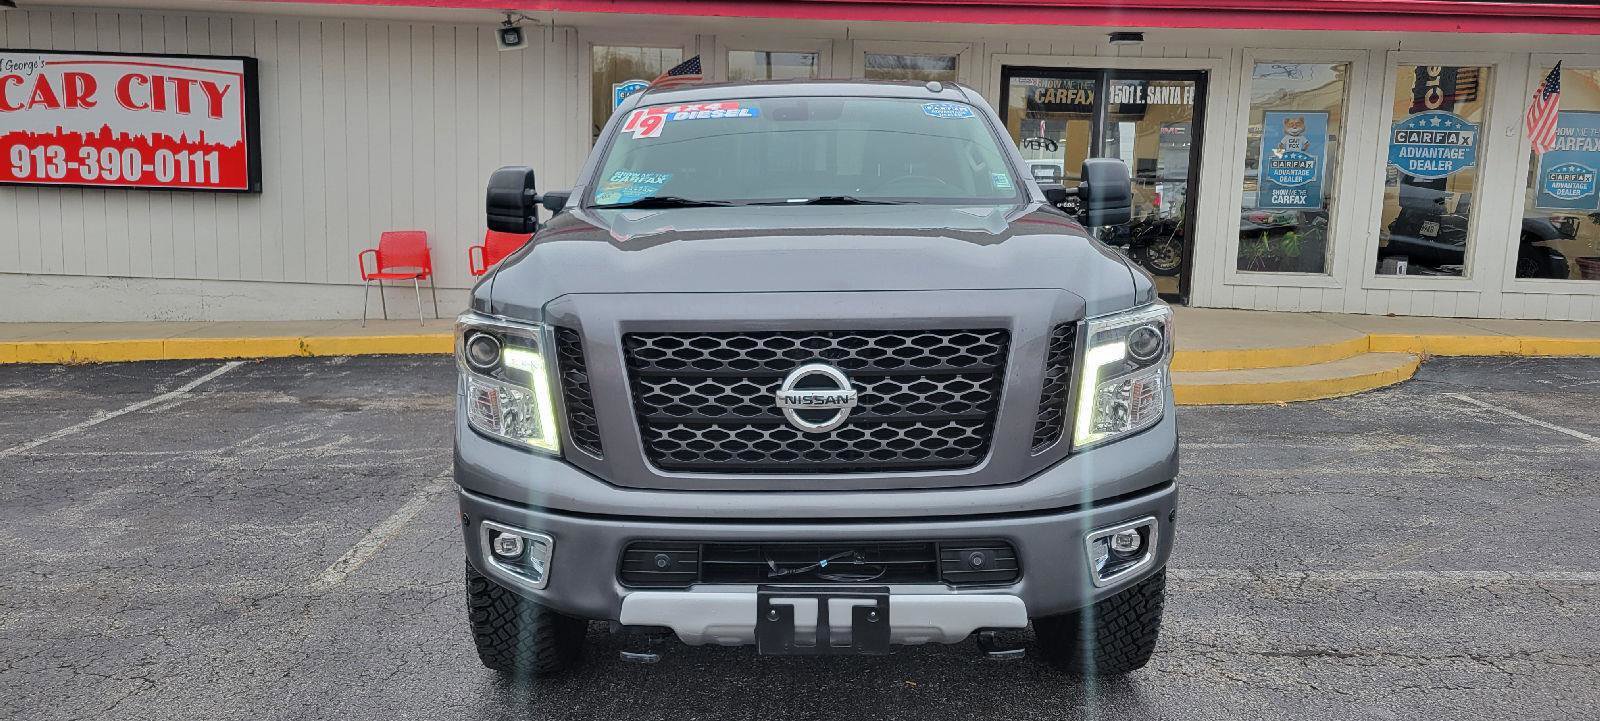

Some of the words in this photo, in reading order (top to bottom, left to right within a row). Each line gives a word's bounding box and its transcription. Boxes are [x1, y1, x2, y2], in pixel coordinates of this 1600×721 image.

[5, 55, 46, 76] George's
[0, 72, 98, 112] CAR
[115, 74, 231, 119] CITY
[1109, 85, 1135, 104] 1501
[1136, 85, 1146, 104] E.
[1147, 86, 1181, 105] SANTA
[673, 107, 753, 121] DIESEL
[625, 110, 663, 136] 19
[1397, 131, 1471, 146] CARFAX
[1555, 127, 1574, 137] HOW
[1555, 136, 1600, 152] ARFAX
[10, 144, 220, 184] 913-390-0111
[1409, 159, 1453, 171] DEALER
[1550, 173, 1592, 182] CARFAX
[1557, 188, 1581, 196] DEALER
[1271, 195, 1308, 204] CARFAX
[784, 393, 849, 405] NISSAN
